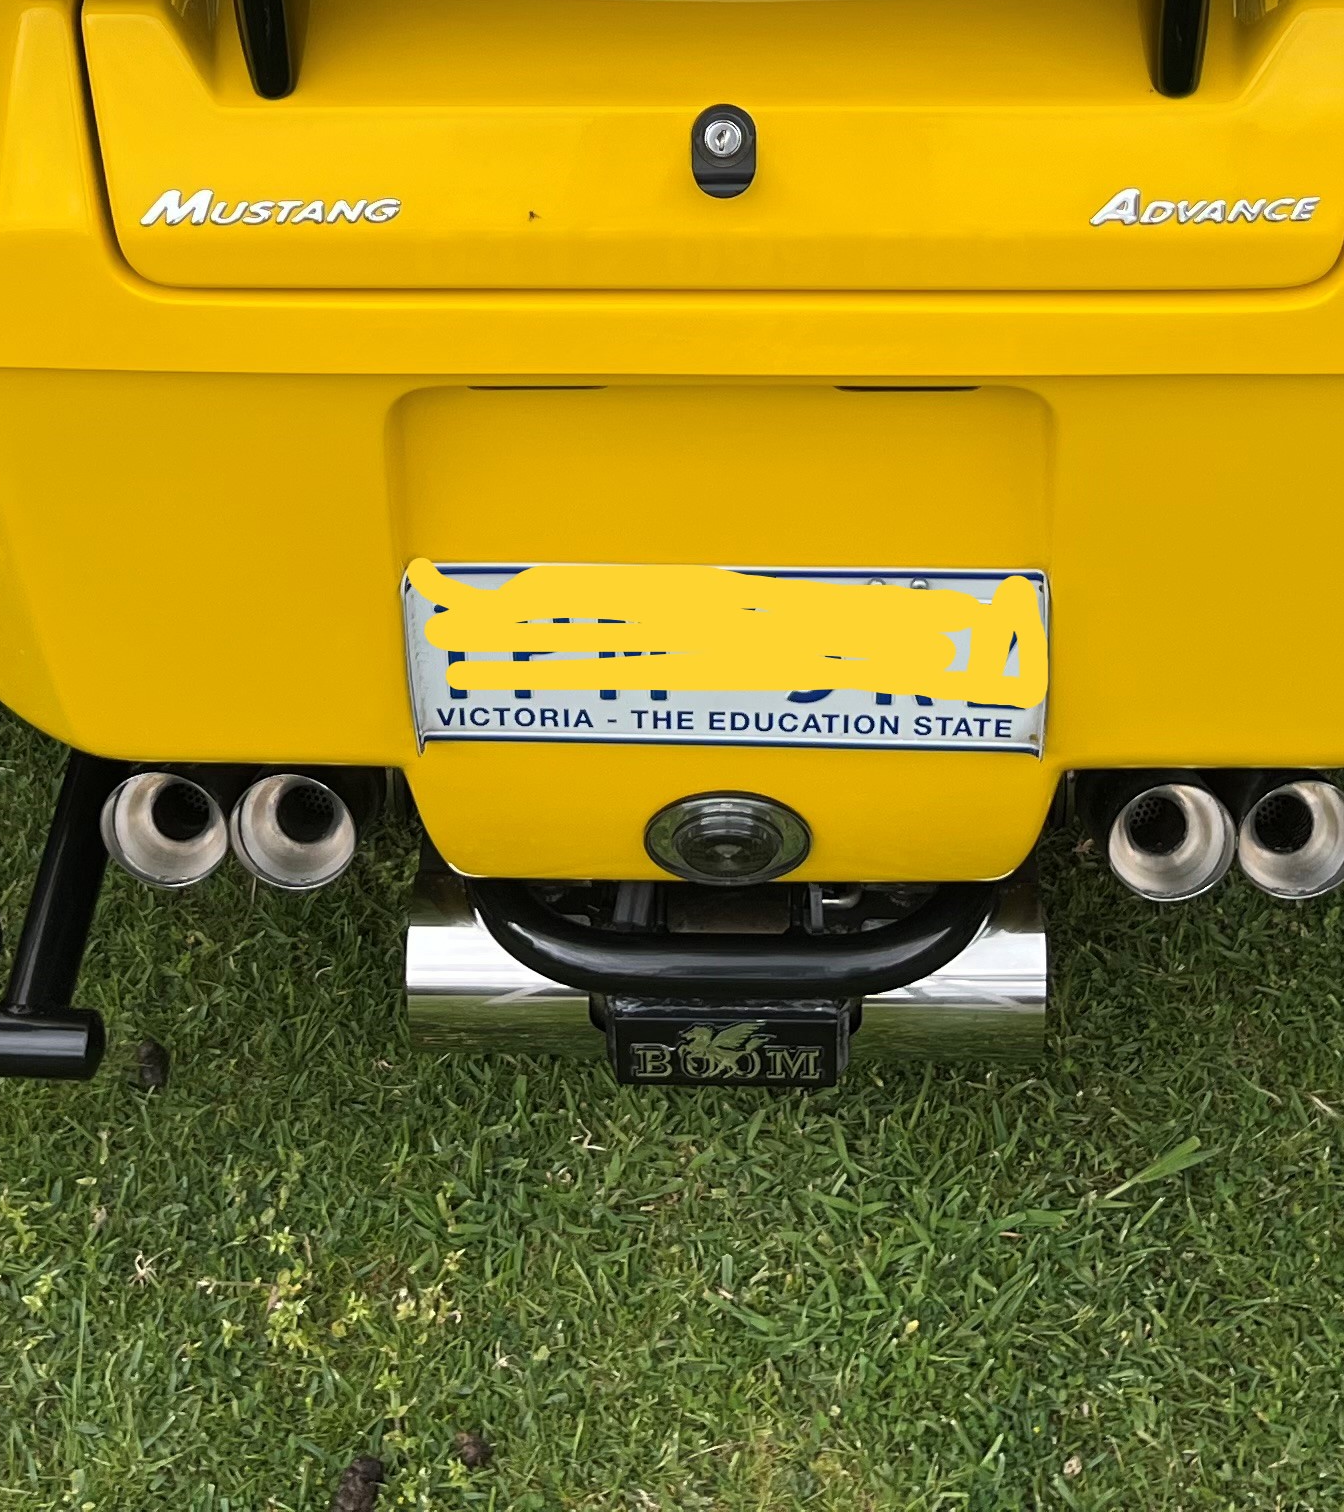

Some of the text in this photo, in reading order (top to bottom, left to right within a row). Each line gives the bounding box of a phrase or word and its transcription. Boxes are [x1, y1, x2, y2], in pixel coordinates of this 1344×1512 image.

[140, 188, 402, 227] MUSTANG
[1089, 187, 1321, 226] ADVANCE
[436, 707, 594, 729] VICTORIA
[630, 709, 695, 730] THE
[708, 711, 900, 735] EDUCATION
[913, 715, 1013, 738] STATE
